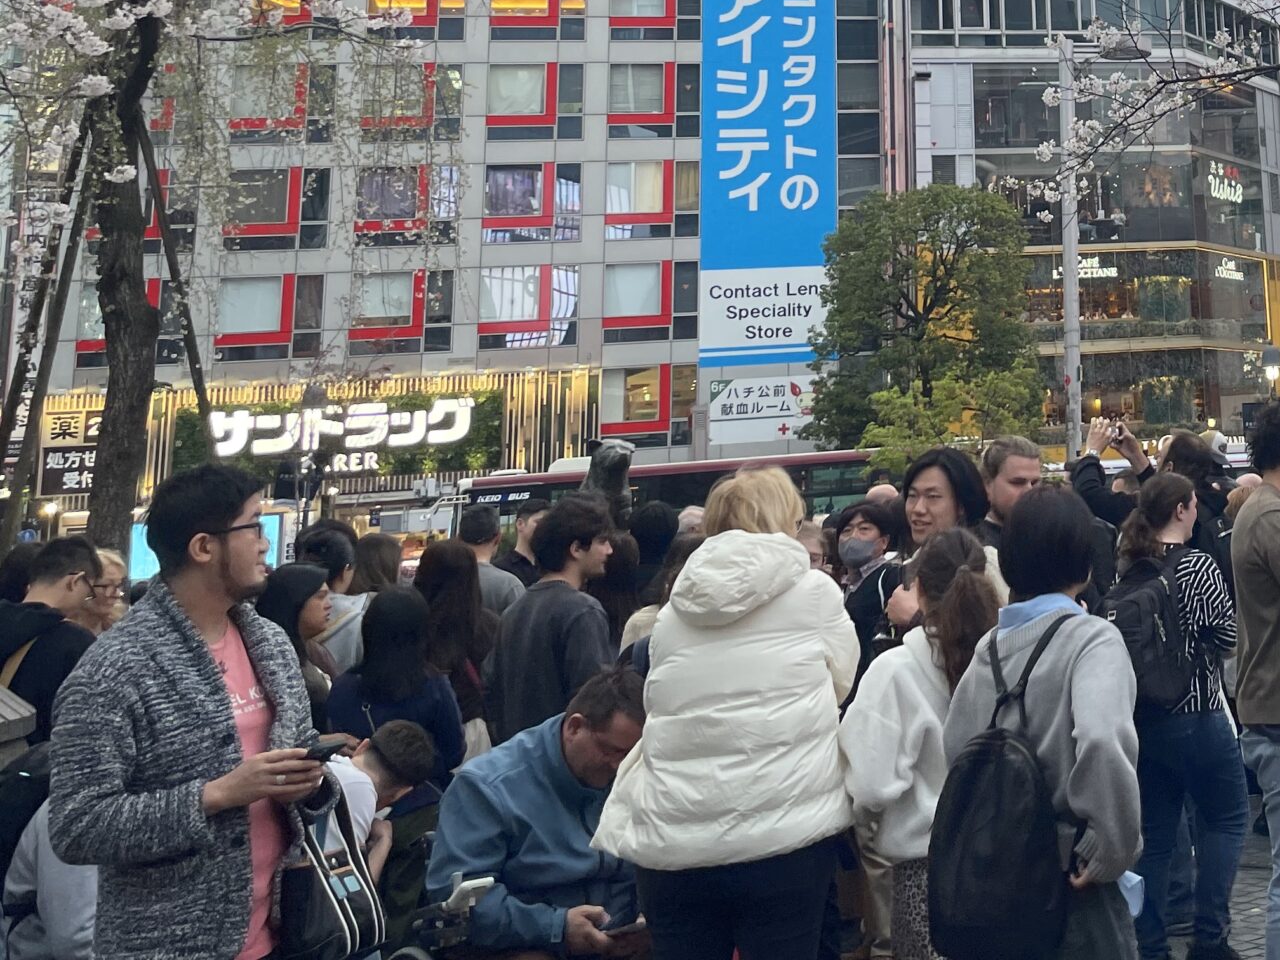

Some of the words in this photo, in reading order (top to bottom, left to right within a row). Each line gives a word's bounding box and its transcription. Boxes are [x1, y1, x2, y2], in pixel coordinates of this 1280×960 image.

[709, 283, 779, 299] Contact
[786, 282, 827, 297] Lens
[726, 302, 812, 320] Speciality
[745, 325, 793, 339] Store
[711, 382, 727, 392] 6F
[727, 385, 786, 399] ハチ公前
[721, 401, 791, 416] 献血ルーム
[50, 416, 80, 441] 薬
[210, 398, 475, 457] サンドラッグ
[477, 494, 501, 503] KEIO
[508, 492, 530, 501] BUS
